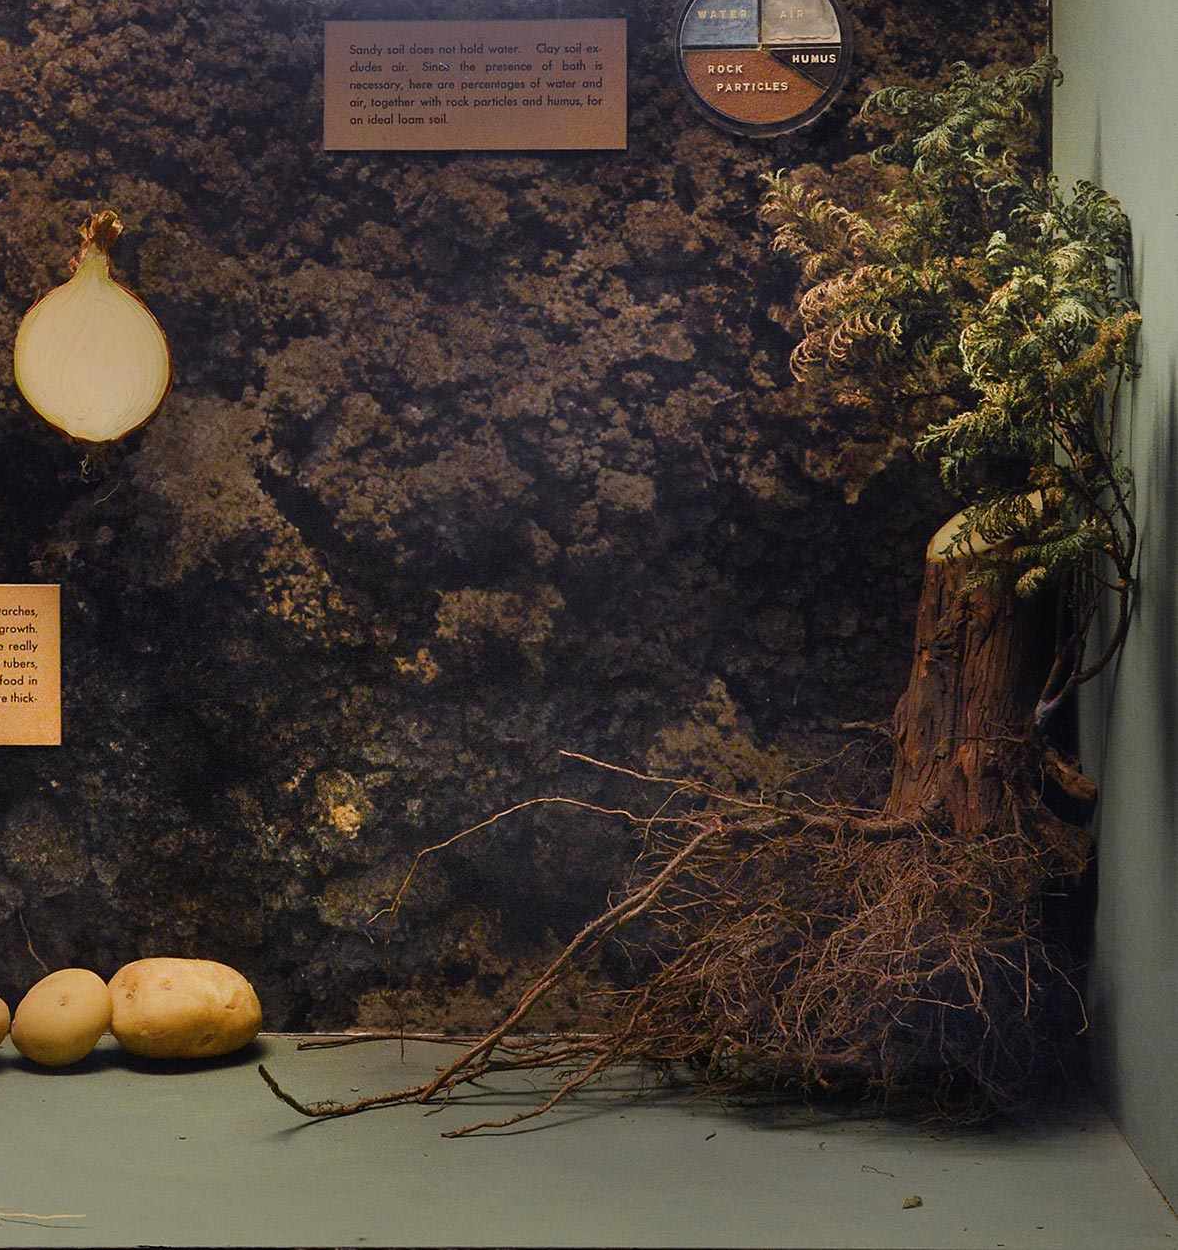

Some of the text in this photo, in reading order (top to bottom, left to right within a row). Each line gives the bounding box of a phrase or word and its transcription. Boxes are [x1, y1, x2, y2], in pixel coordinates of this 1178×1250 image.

[697, 9, 748, 19] WATER
[780, 9, 804, 19] AIR
[792, 54, 837, 64] HUMUS
[708, 64, 744, 74] ROCK
[350, 82, 403, 91] necessary,
[409, 78, 432, 89] here
[461, 81, 525, 91] percentages
[530, 77, 540, 88] of
[547, 80, 576, 88] water
[582, 77, 602, 88] and
[716, 82, 789, 92] PARTICLES
[350, 95, 603, 109] air, together with rock particles and humus, for
[4, 657, 37, 669] tubers,
[0, 675, 23, 685] food
[29, 676, 37, 685] in
[11, 692, 38, 703] thick-
